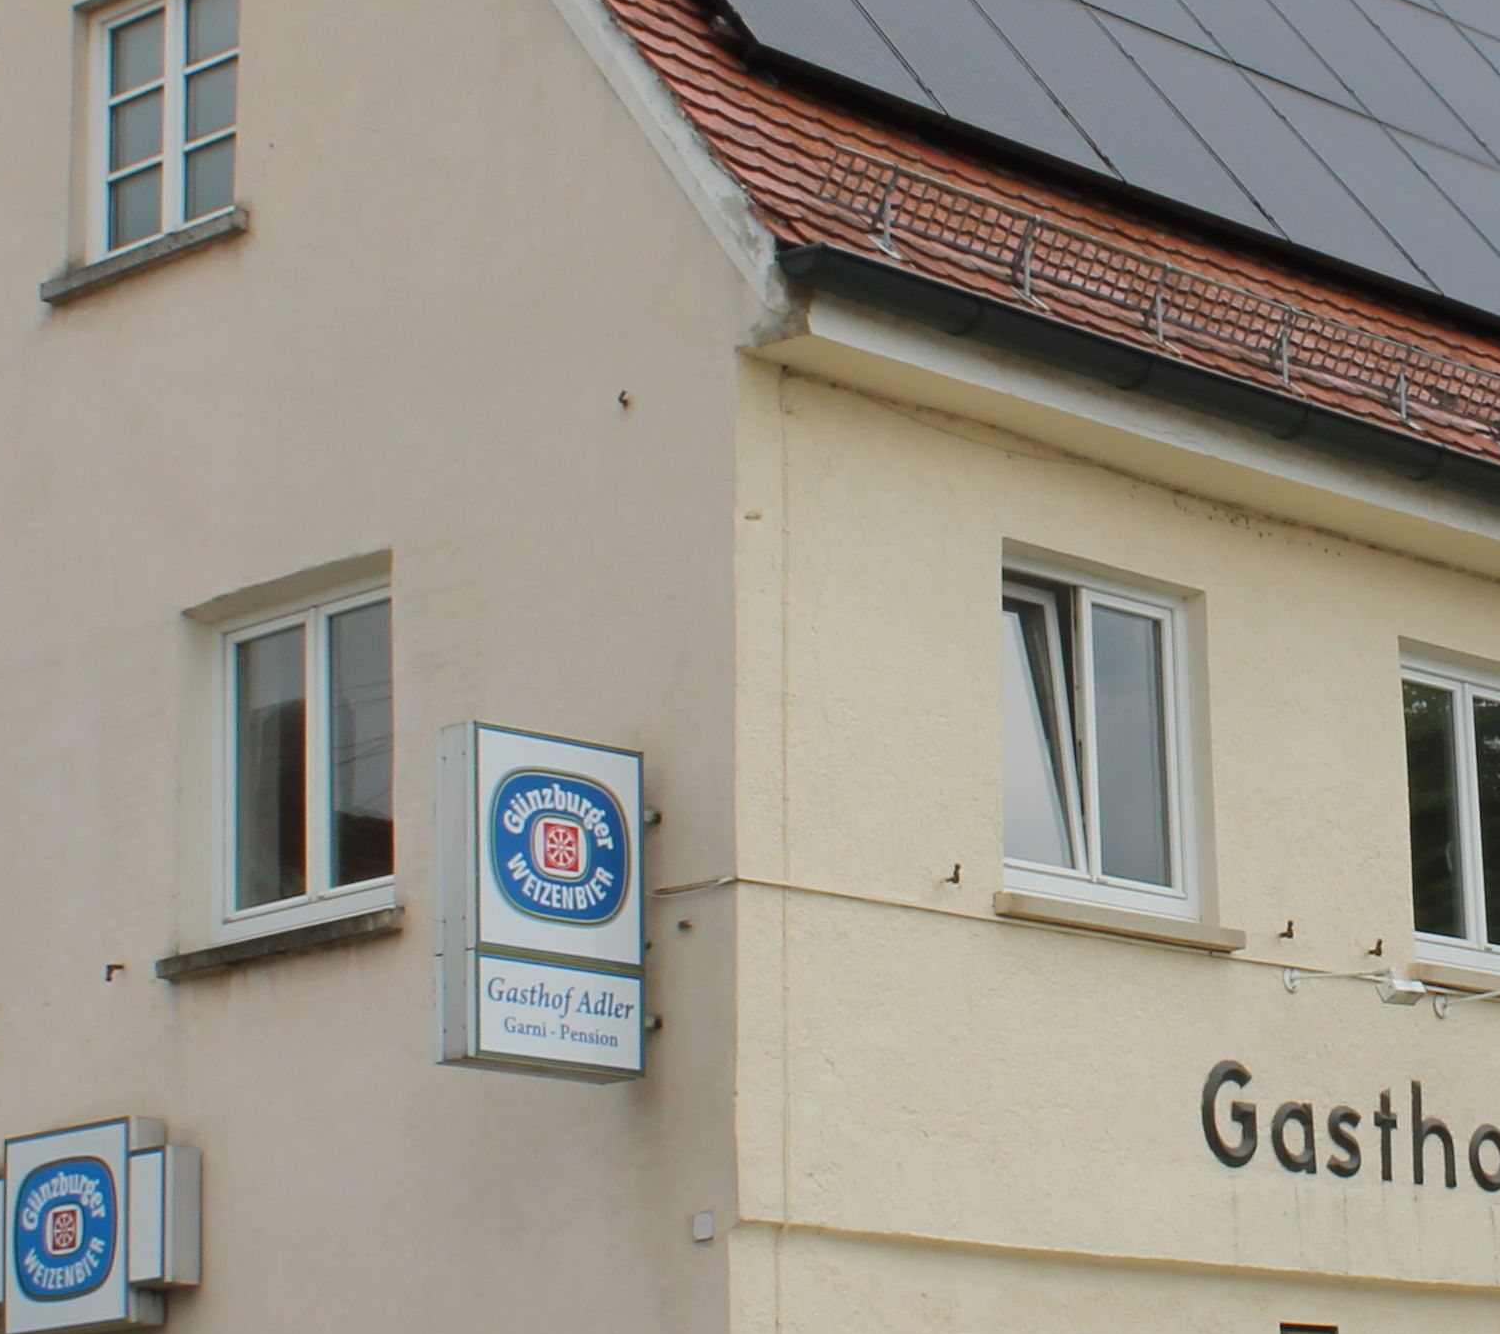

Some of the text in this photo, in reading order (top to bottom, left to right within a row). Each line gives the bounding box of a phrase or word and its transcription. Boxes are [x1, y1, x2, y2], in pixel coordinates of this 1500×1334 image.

[503, 782, 614, 852] Günzburger
[507, 851, 615, 911] WEIZENBIER
[487, 976, 635, 1020] Gasthof Adler
[504, 1016, 547, 1038] Garni
[559, 1024, 619, 1048] Pension
[21, 1171, 107, 1232] Günzburger
[24, 1236, 106, 1290] WEIZENBIER
